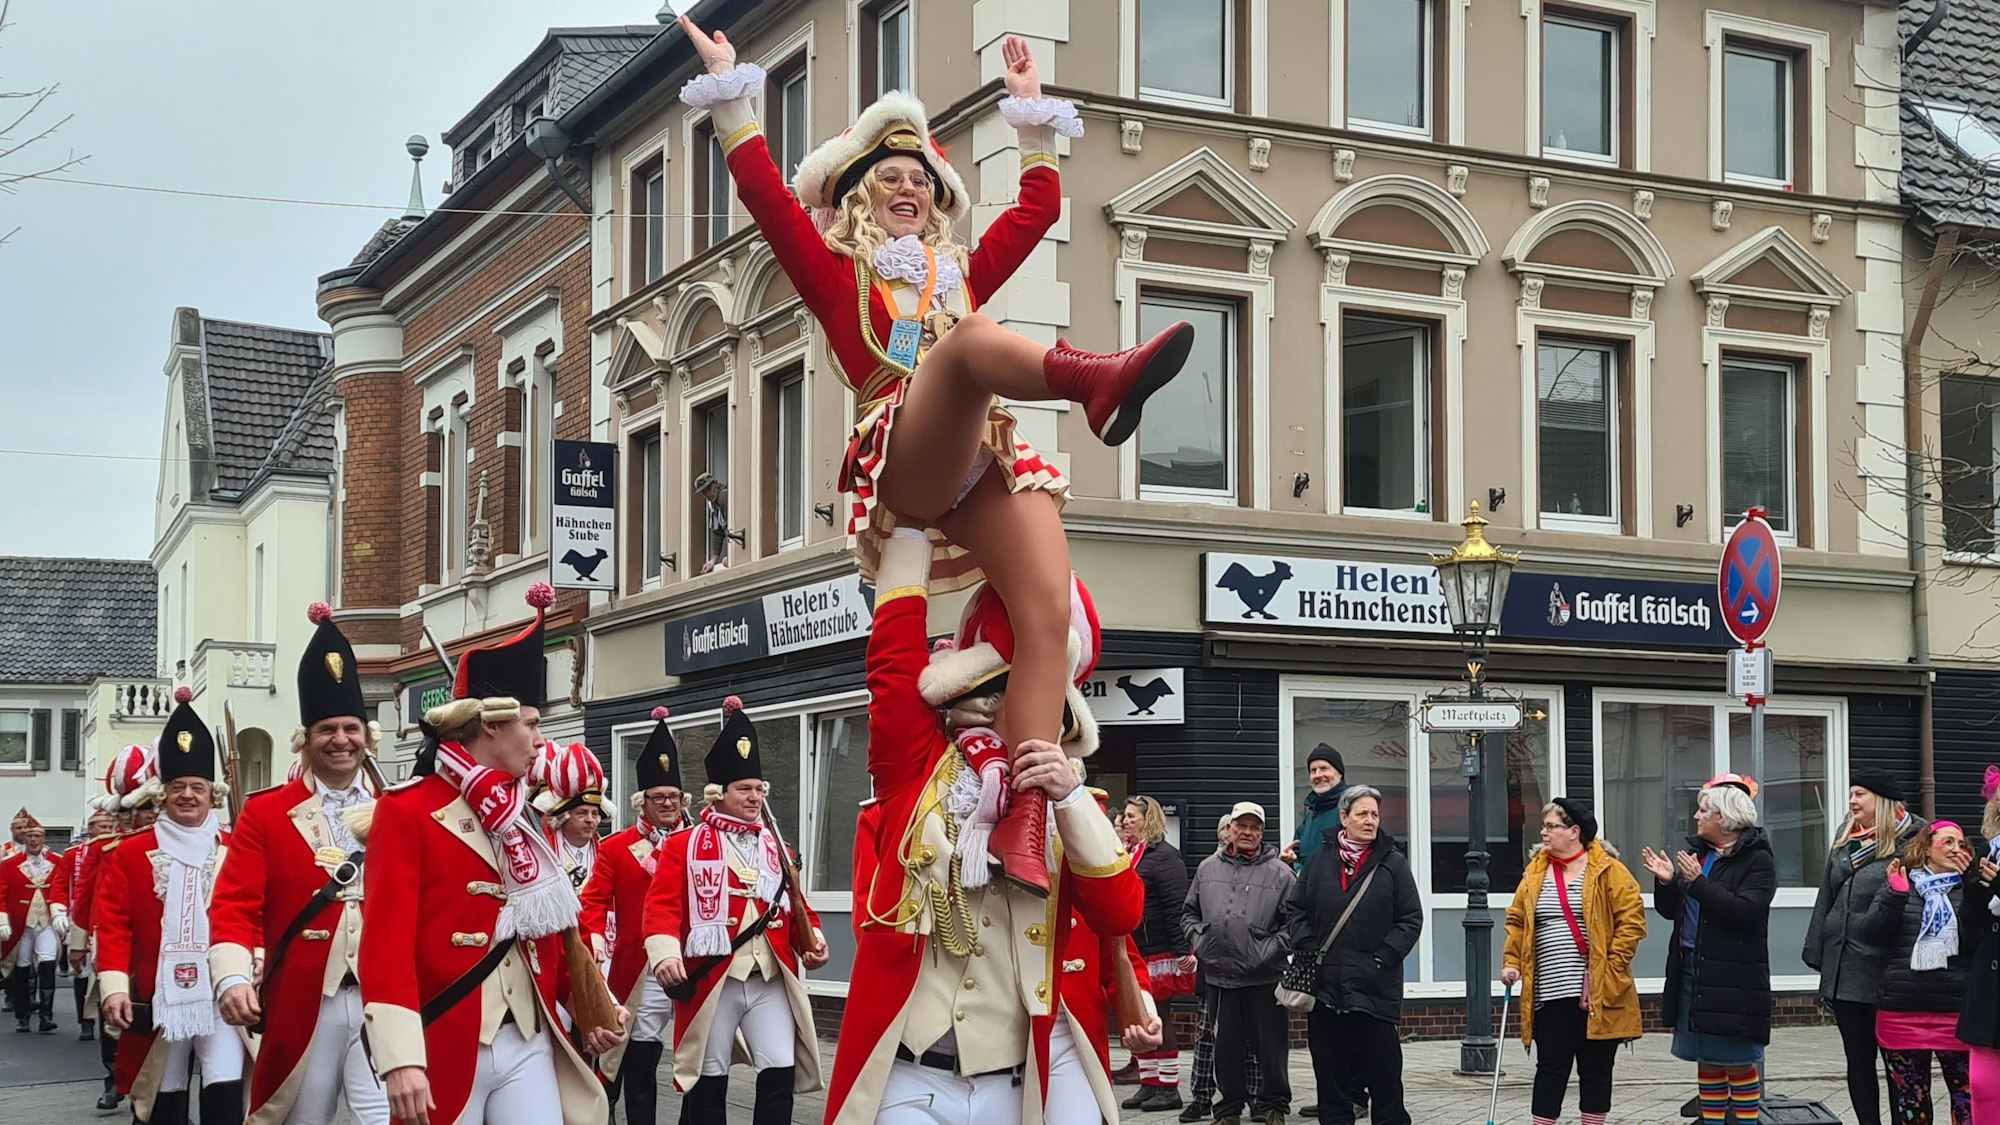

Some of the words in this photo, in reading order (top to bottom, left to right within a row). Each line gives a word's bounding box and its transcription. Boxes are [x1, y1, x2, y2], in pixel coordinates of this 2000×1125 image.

[561, 468, 606, 488] Gaffel
[570, 487, 598, 499] Kölsch
[556, 516, 612, 530] Hähnchen
[568, 529, 600, 541] Stube
[782, 583, 840, 619] Helen's
[1298, 590, 1448, 625] Hähnchenst
[1575, 591, 1636, 625] Gaffel
[1641, 595, 1711, 631] Kölsch
[692, 625, 720, 654] Gaffel
[719, 617, 749, 648] Kölsch
[769, 607, 858, 648] Hähnchenstube
[1441, 709, 1507, 723] Marktplatz
[695, 867, 720, 887] BNZ
